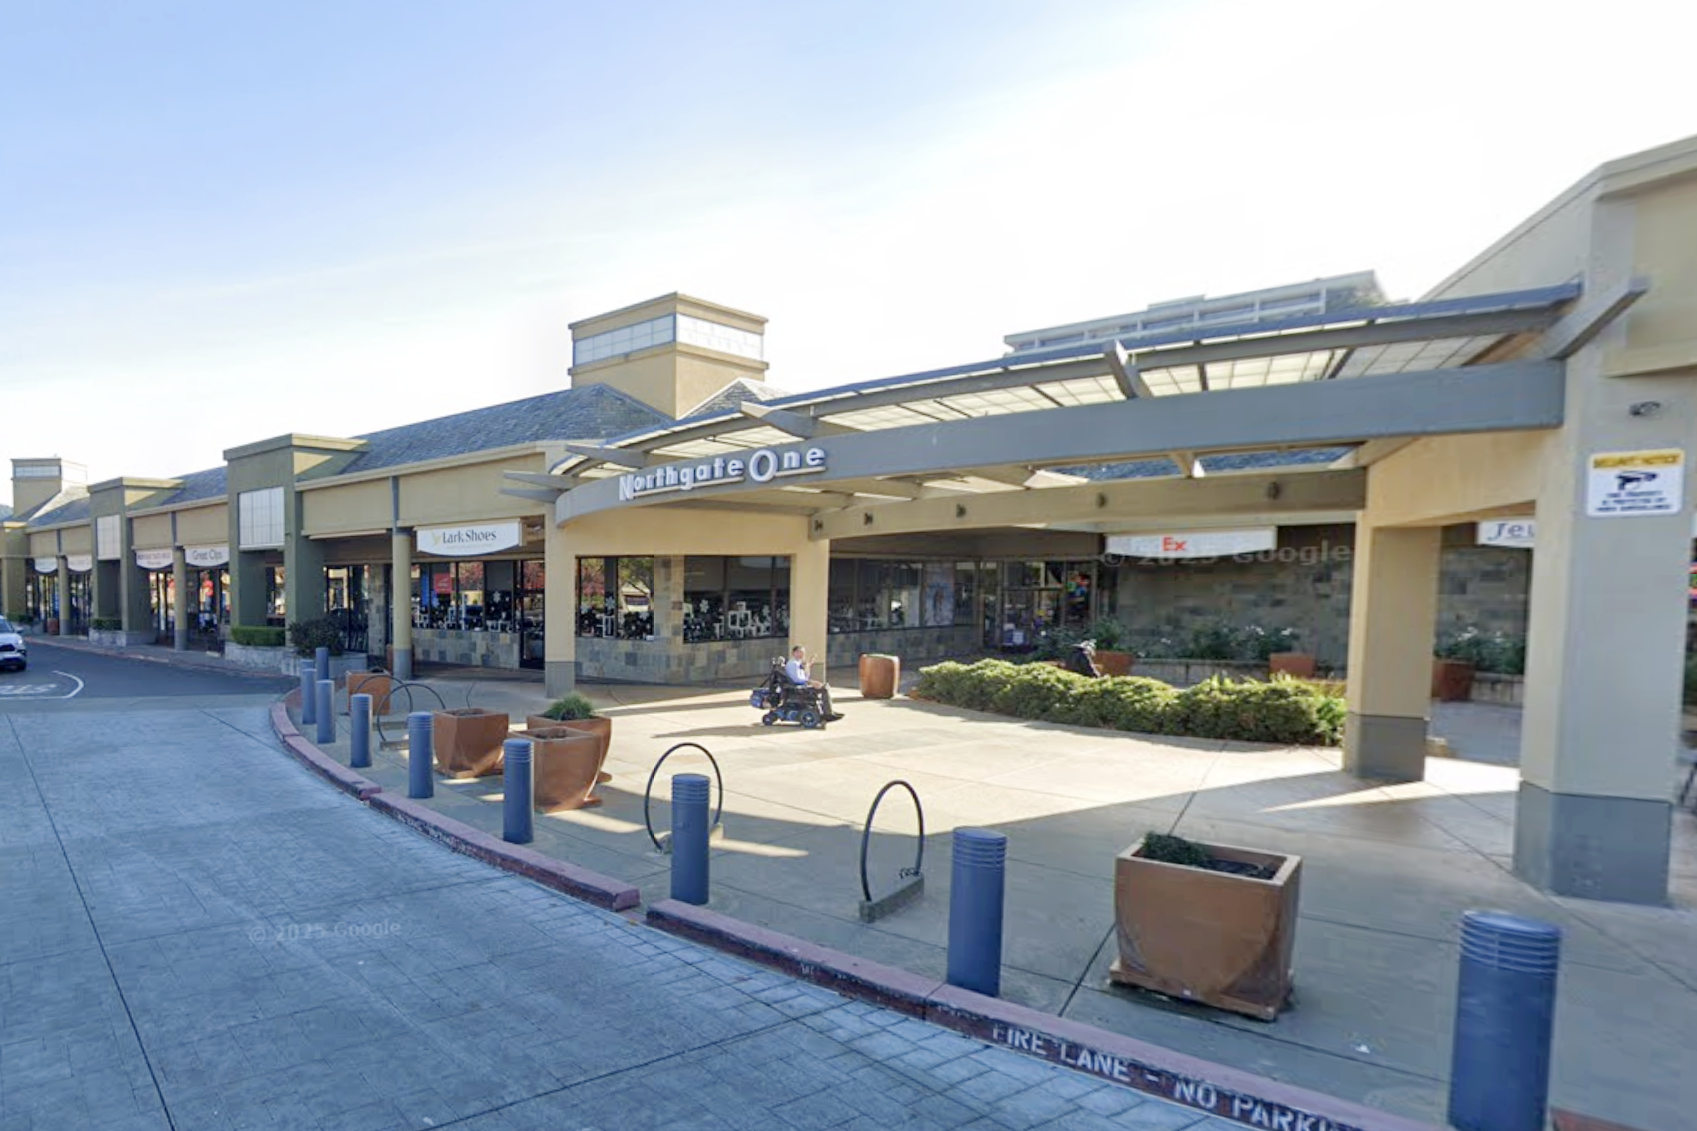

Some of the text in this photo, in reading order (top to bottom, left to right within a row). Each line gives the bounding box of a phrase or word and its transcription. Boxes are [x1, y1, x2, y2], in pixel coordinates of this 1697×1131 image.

[619, 447, 826, 500] Northgate One
[443, 529, 497, 543] Lark Shoes
[993, 1023, 1048, 1055] FIRE
[1060, 1041, 1130, 1082] LANE
[1174, 1080, 1217, 1109] NO
[1231, 1096, 1337, 1131] PARKI
